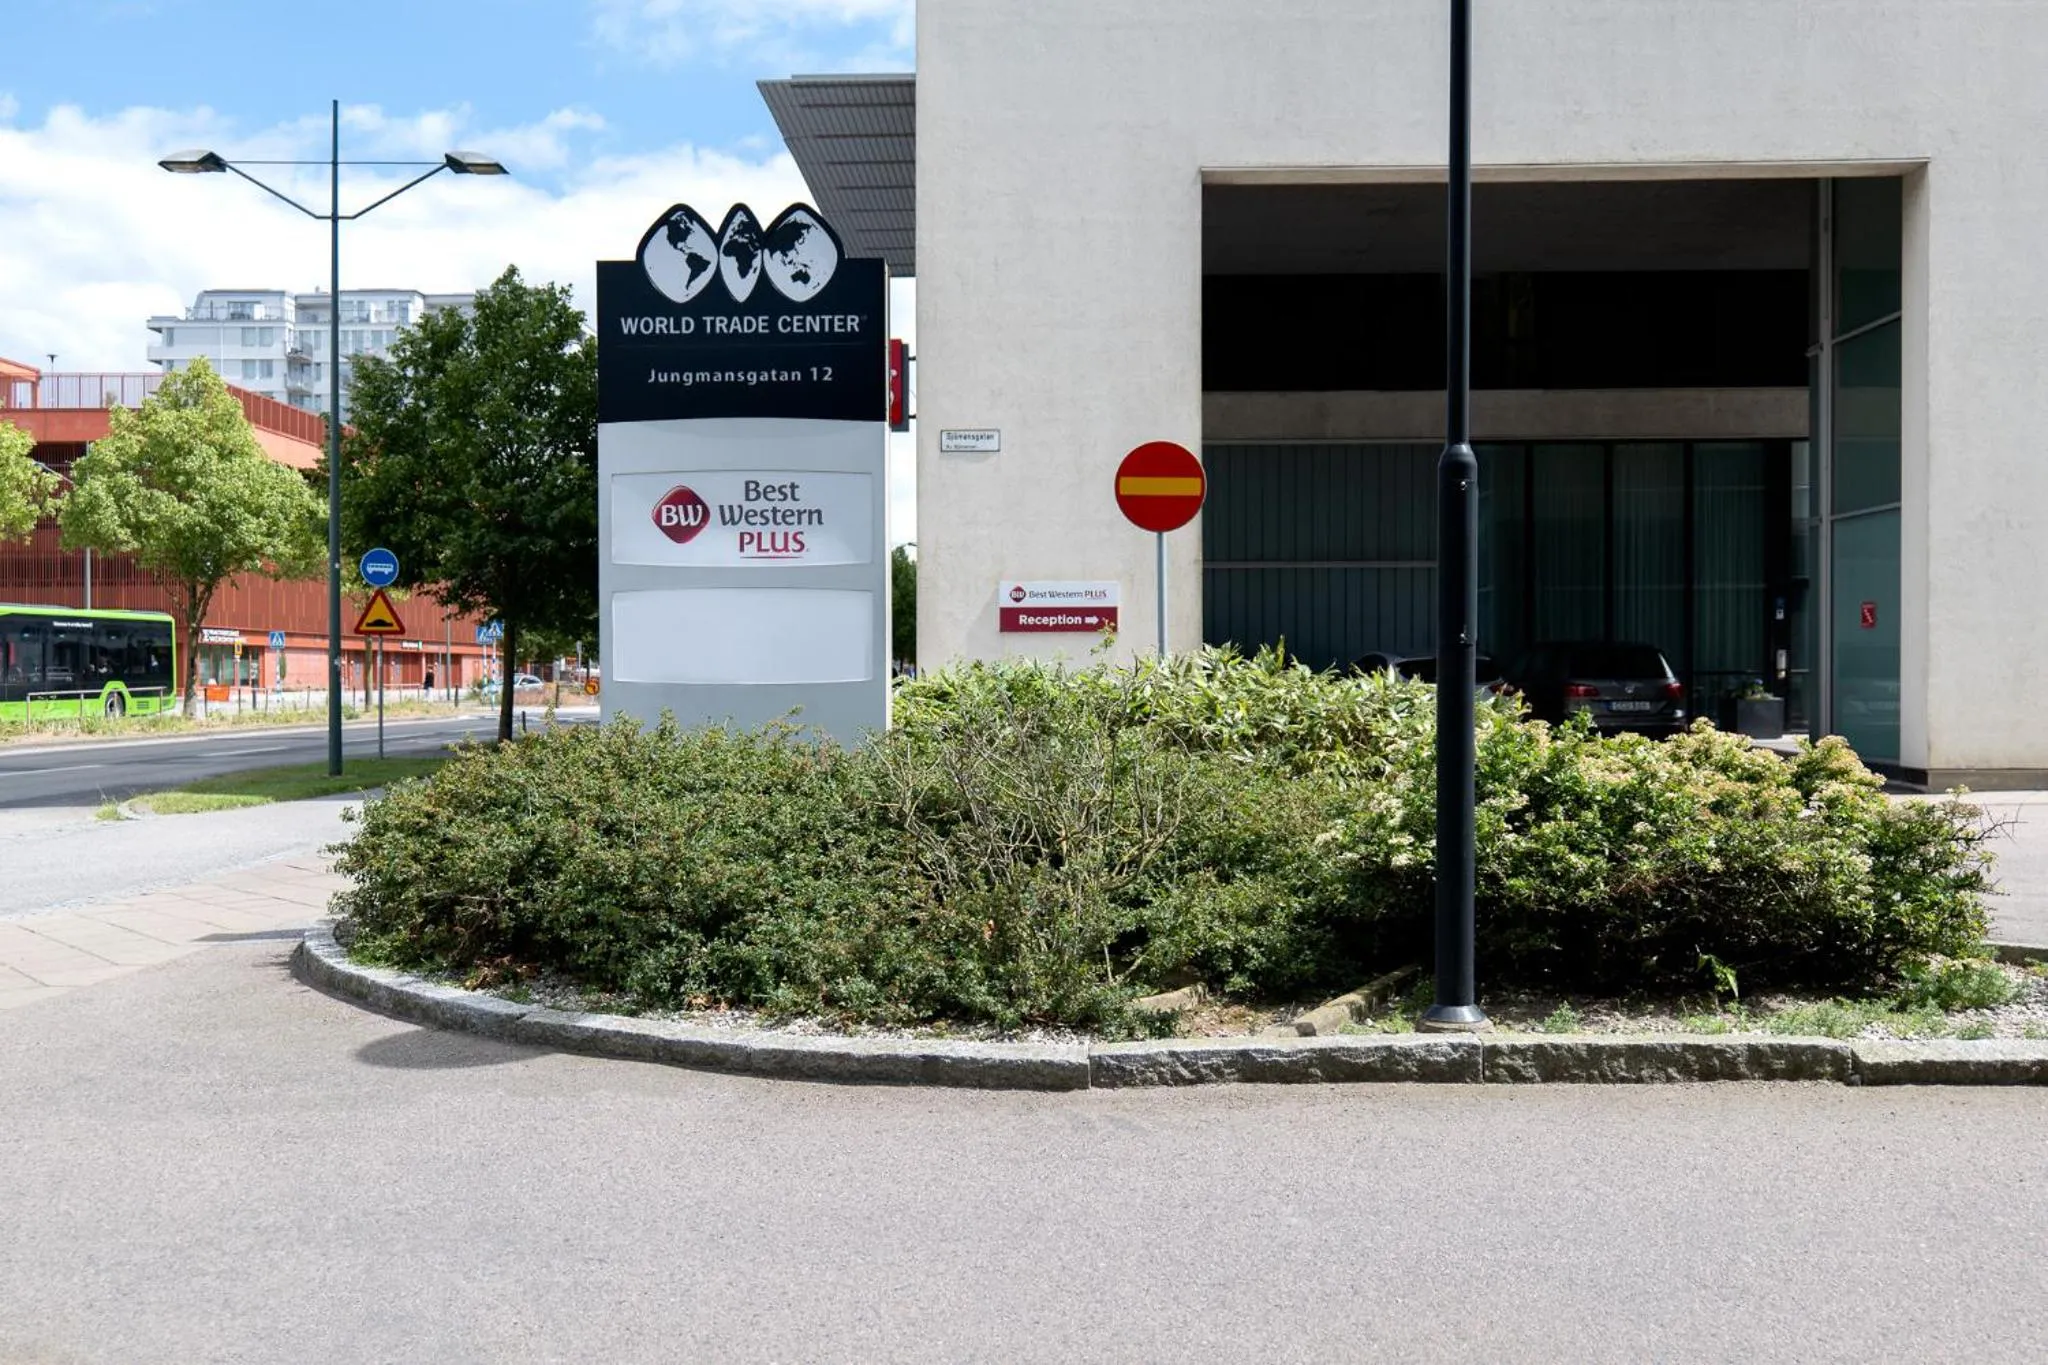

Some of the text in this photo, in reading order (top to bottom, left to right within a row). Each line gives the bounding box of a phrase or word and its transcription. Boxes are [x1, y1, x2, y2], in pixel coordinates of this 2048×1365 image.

[620, 314, 860, 335] WORLD TRADE CENTER
[647, 366, 833, 386] Jungmansgatan 12
[744, 480, 801, 502] Best
[661, 504, 703, 527] BW
[718, 504, 824, 526] Western
[739, 531, 806, 553] PLUS
[1028, 589, 1107, 599] Best Western PLUS
[1018, 614, 1083, 627] Reception
